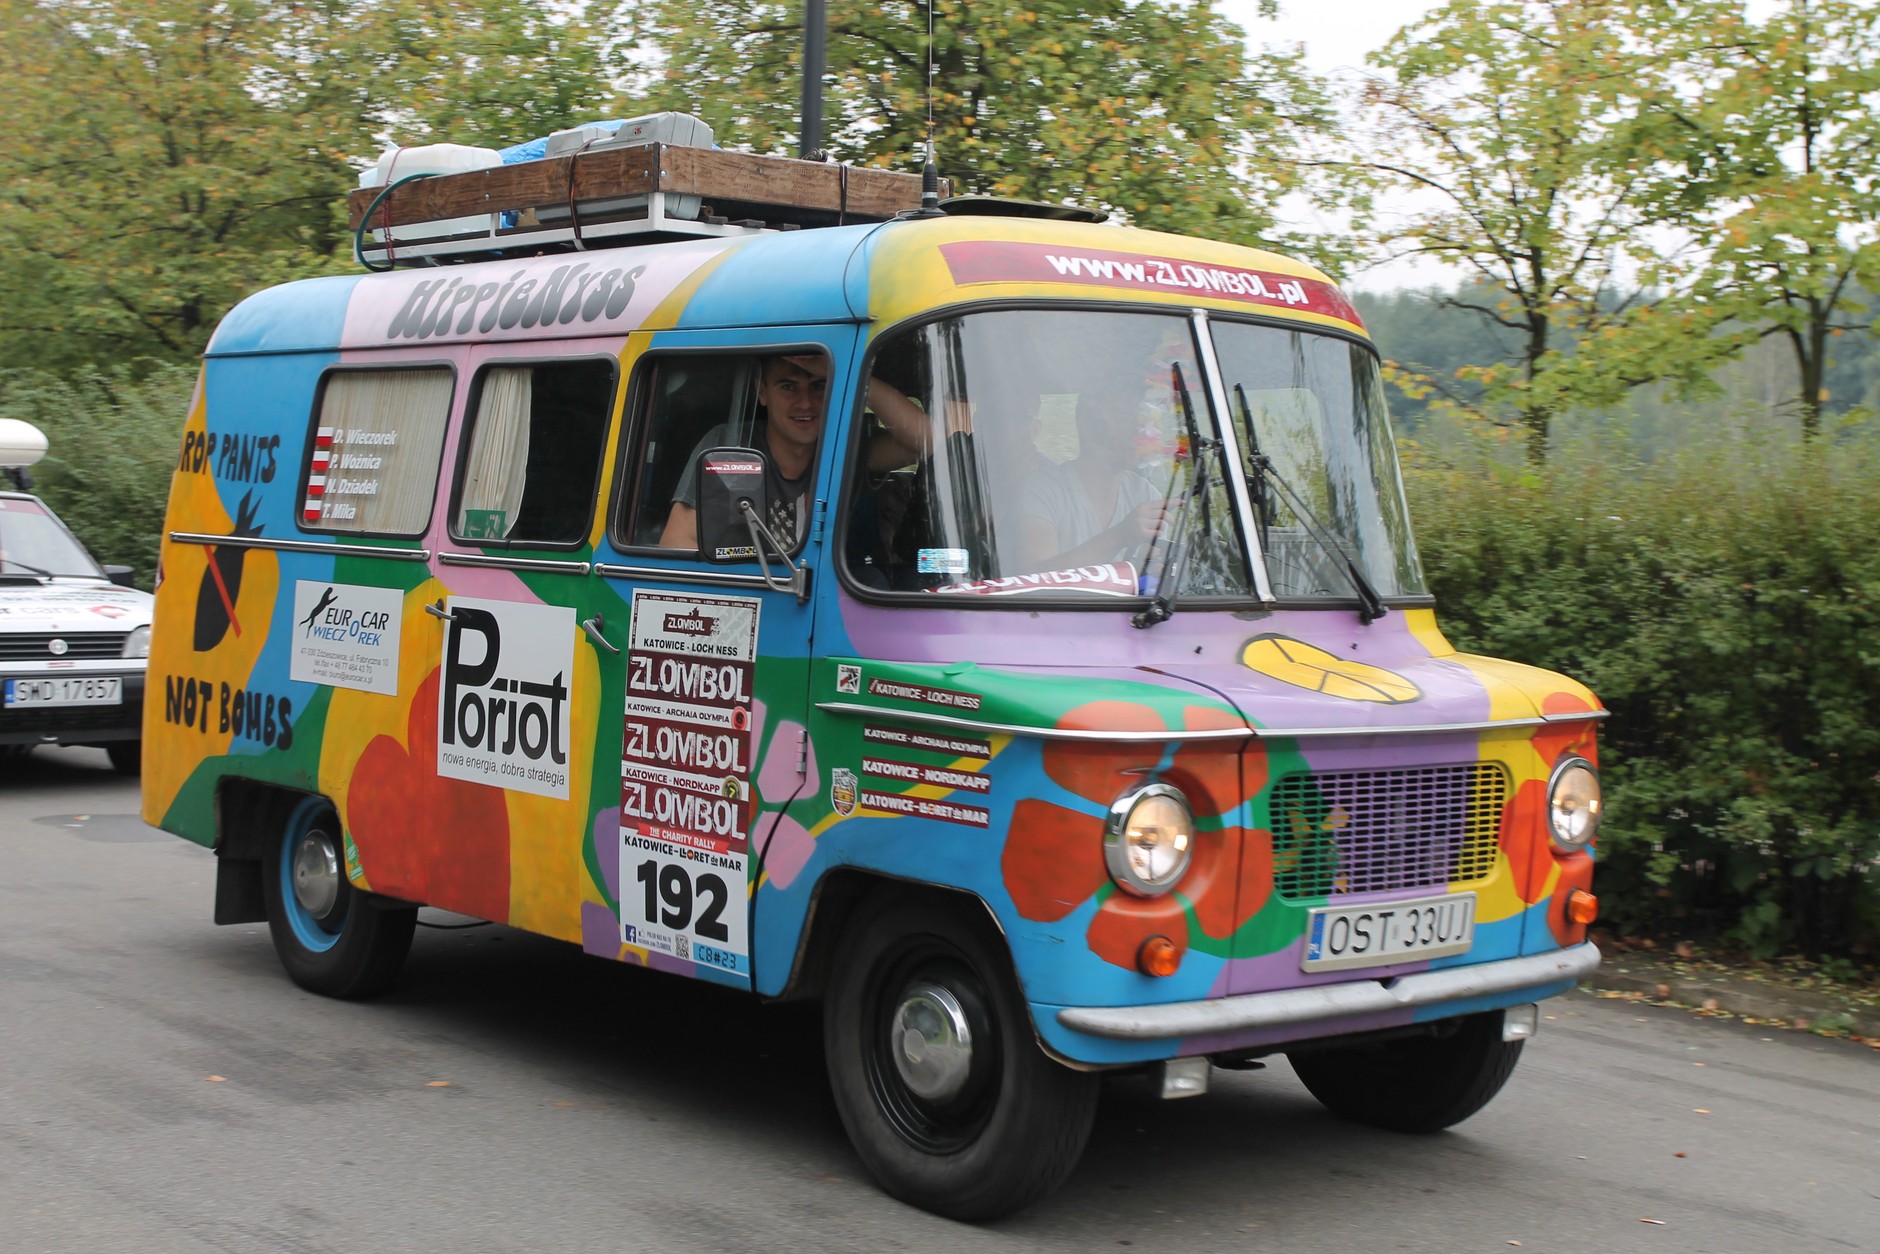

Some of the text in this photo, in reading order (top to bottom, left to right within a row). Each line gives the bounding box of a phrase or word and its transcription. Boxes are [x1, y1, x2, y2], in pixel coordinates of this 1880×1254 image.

[333, 429, 397, 445] D. Wieczorek
[217, 433, 281, 484] PANTS
[329, 453, 382, 470] P. Woźnica
[325, 479, 378, 495] N. Dziadek
[322, 504, 330, 519] T.
[643, 638, 685, 651] KATOWICE
[691, 642, 714, 654] LOCH
[716, 645, 738, 656] NESS
[63, 680, 118, 700] 17857
[442, 606, 567, 765] Porjot
[876, 683, 922, 699] KATOWICE
[927, 691, 953, 704] LOCH
[954, 695, 980, 709] NESS
[165, 675, 294, 751] NOT BOMBS
[627, 703, 661, 714] KATOWICE
[665, 707, 698, 719] ARCHAIA
[699, 712, 730, 723] OLYMPIA
[864, 728, 907, 742] KATOWICE
[911, 735, 950, 749] ARCHAIA
[951, 741, 989, 755] OLYMPIA
[442, 752, 565, 787] nowa energia, dobra strategia
[626, 768, 668, 784] KATOWICE
[673, 776, 720, 794] NORDKAPP
[862, 760, 919, 779] KATOWICE
[924, 769, 990, 790] NORDKAPP
[963, 810, 988, 824] MAR
[649, 827, 716, 850] THE CHARITY RALLY
[711, 857, 719, 866] de
[719, 858, 742, 872] MAR
[637, 859, 728, 943] 192
[1329, 902, 1468, 955] OST 33UJ
